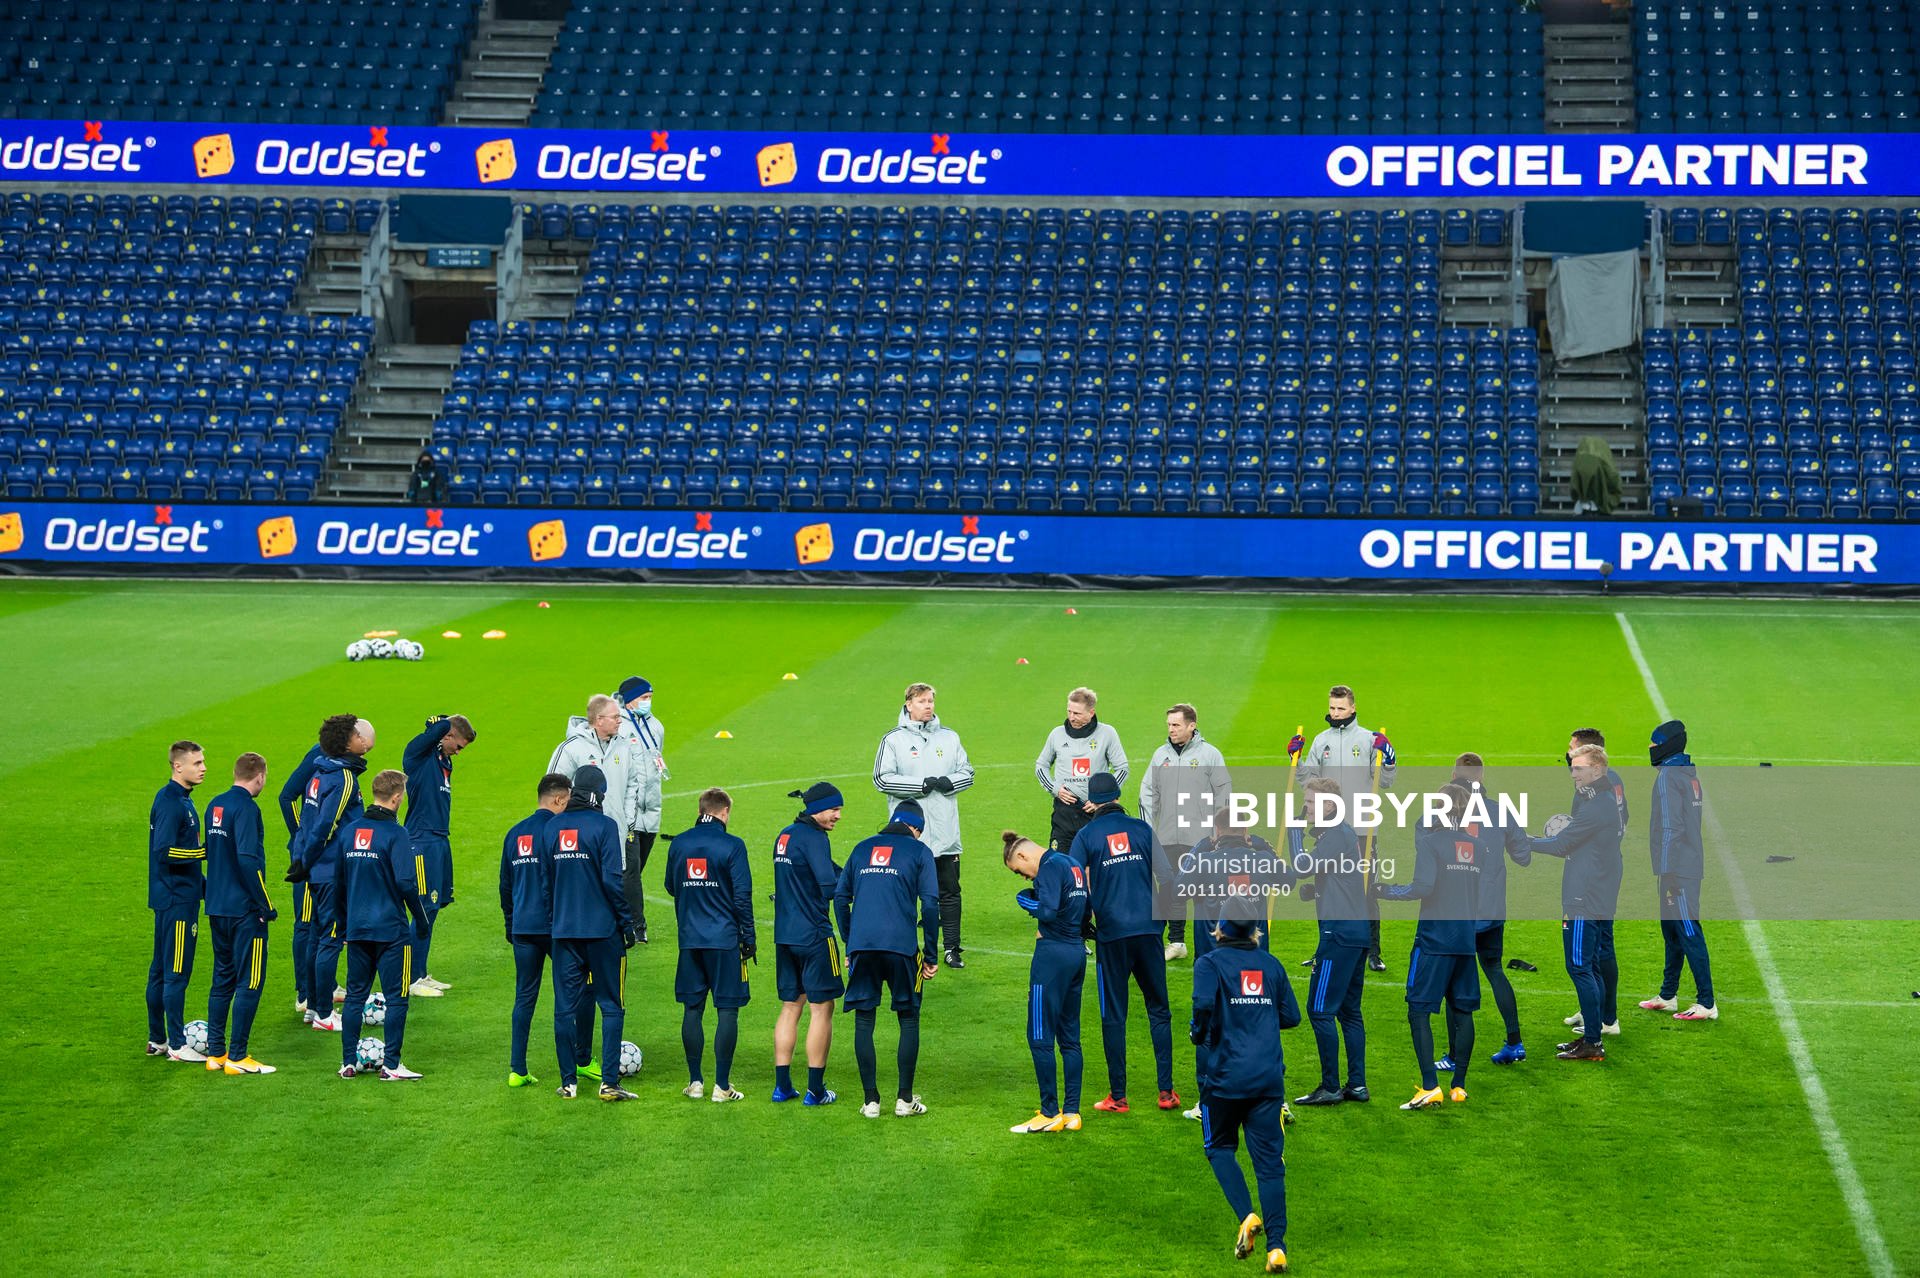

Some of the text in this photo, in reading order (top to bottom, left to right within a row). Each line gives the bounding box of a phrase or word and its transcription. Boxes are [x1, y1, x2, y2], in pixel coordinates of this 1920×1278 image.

[0, 136, 142, 172] ddset
[1326, 144, 1868, 187] OFFICIEL PARTNER
[1360, 530, 1878, 573] OFFICIEL PARTNER
[1102, 855, 1128, 867] SVENSKA
[704, 880, 719, 888] SPEL
[1230, 997, 1260, 1005] SVENSKA
